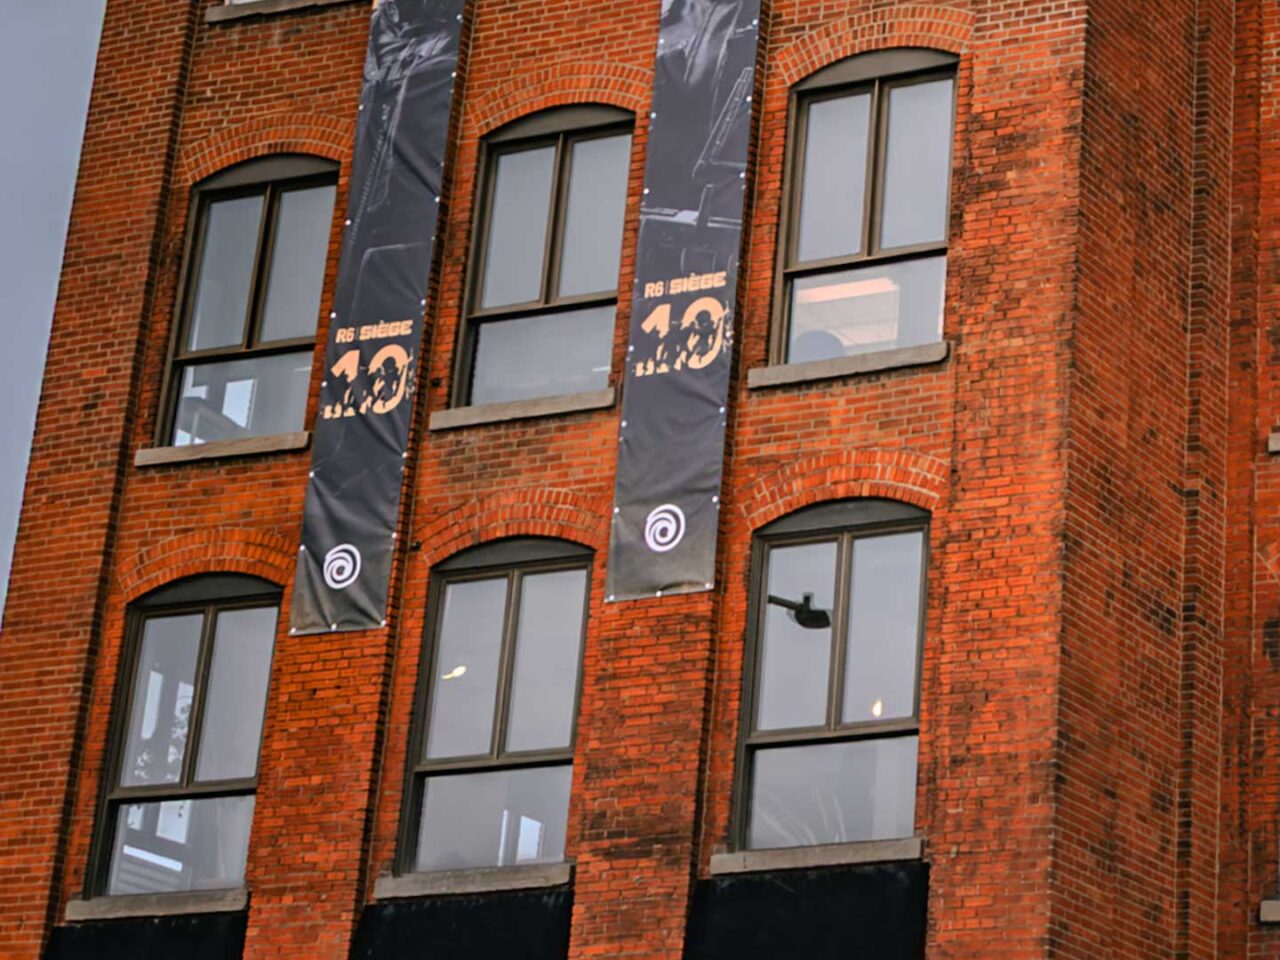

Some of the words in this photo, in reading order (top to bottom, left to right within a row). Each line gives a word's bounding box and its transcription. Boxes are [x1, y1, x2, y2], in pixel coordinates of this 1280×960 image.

[644, 281, 665, 298] R6
[669, 271, 727, 295] SIÈGE
[335, 327, 355, 343] R6
[359, 320, 414, 340] SIÈGE
[635, 297, 724, 377] 10
[323, 344, 409, 419] 10
